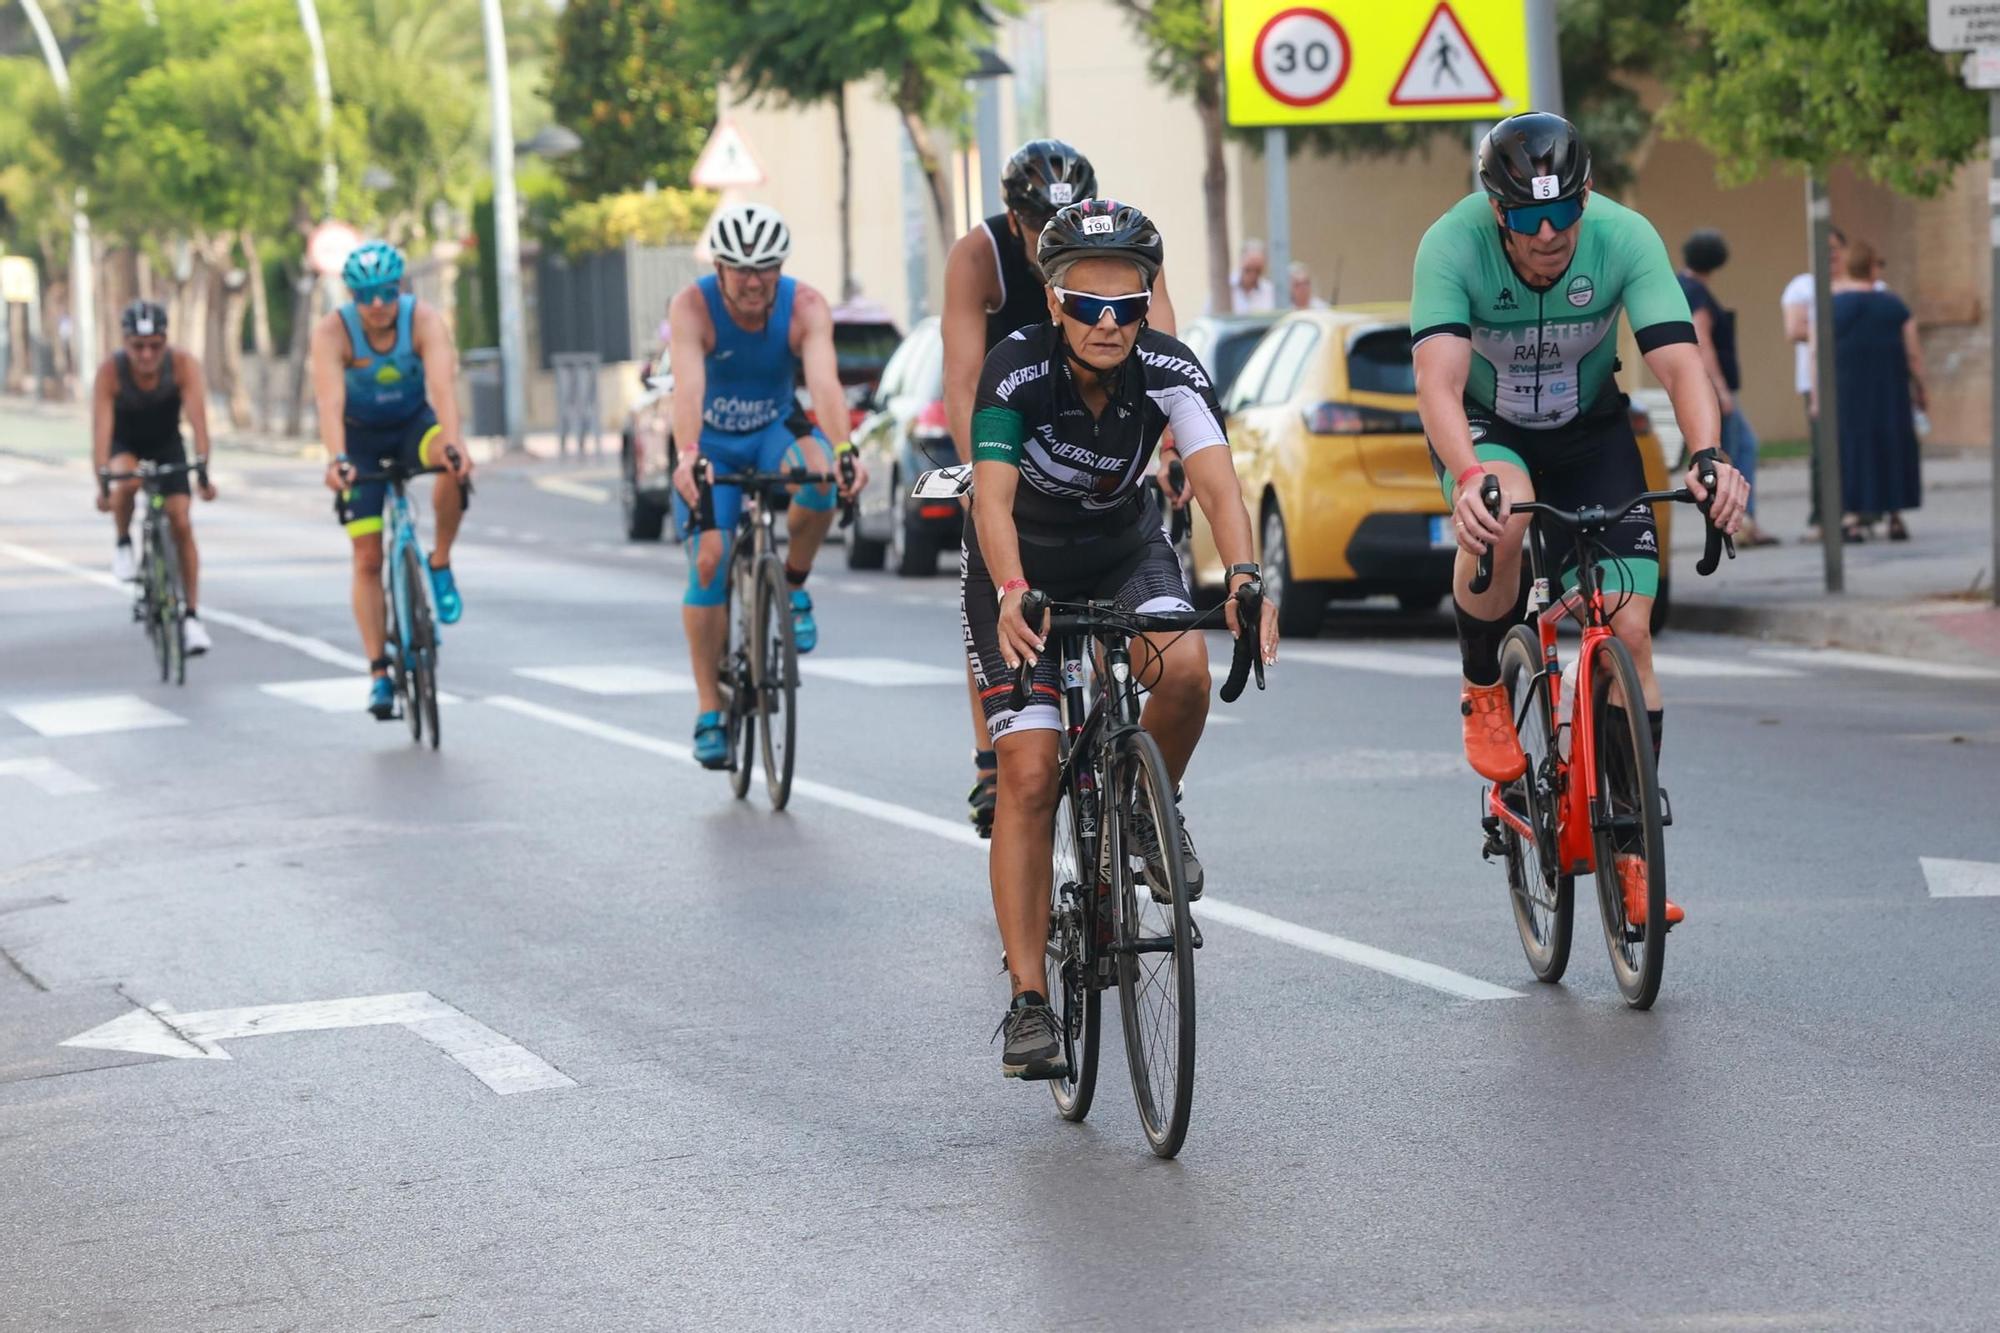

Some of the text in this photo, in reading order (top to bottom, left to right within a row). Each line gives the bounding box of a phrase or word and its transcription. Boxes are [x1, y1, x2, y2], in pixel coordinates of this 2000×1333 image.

[1274, 42, 1329, 73] 30
[1053, 190, 1070, 202] 125
[1542, 185, 1550, 197] 5
[1087, 222, 1110, 233] 190
[1513, 342, 1561, 361] RAFA
